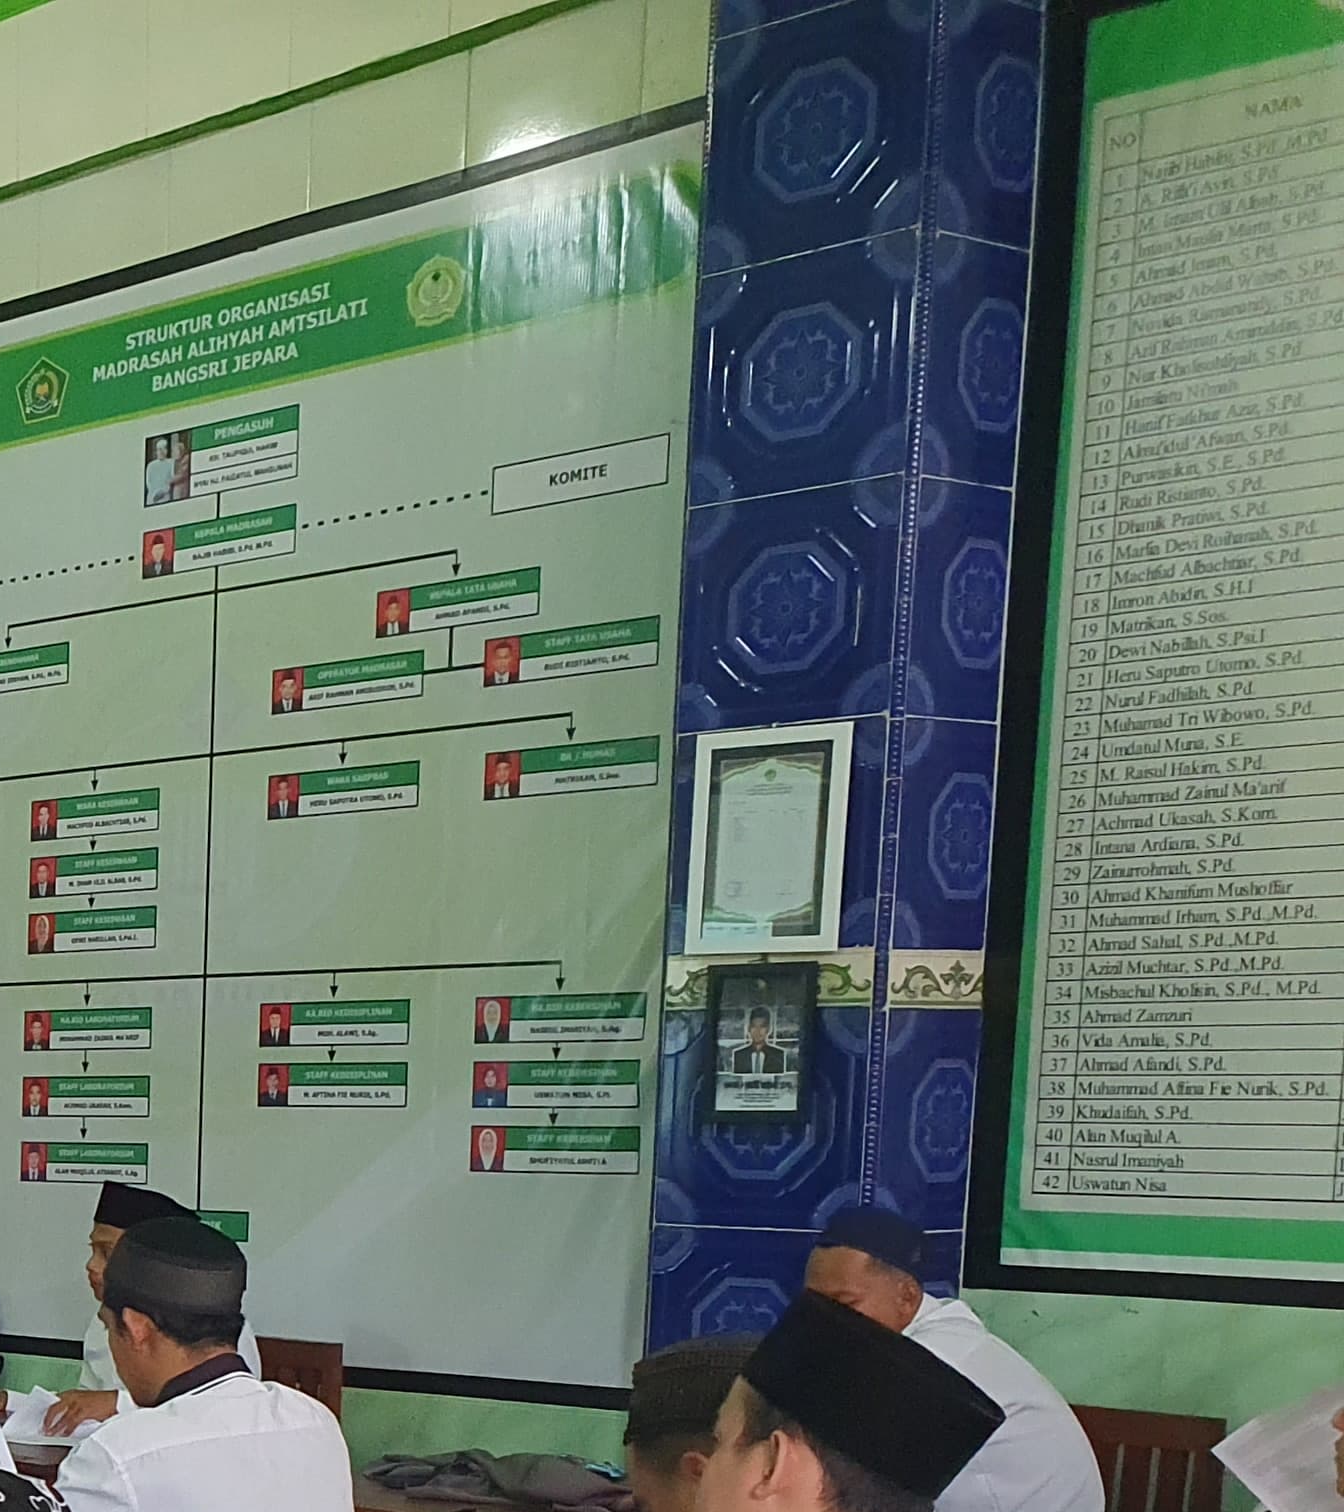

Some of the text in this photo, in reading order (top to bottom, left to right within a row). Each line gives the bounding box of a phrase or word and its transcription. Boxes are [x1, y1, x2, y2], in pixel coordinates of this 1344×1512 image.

[126, 282, 331, 350] STRUKTUR ORGANISASI
[92, 298, 369, 383] MADRASAH ALIHYAH AMTSILATI
[152, 342, 298, 392] BANGSRI JEPARA
[214, 417, 274, 440] PENGASUH
[550, 464, 607, 486] KOMITE
[1075, 697, 1092, 711] 22
[1105, 692, 1144, 710] Nurul
[1073, 722, 1090, 736] 23
[1178, 711, 1198, 727] Tri
[1203, 705, 1270, 724] Wibowo,
[1071, 746, 1089, 759] 24
[1102, 739, 1161, 759] Umdatul
[1070, 770, 1088, 785] 25
[1069, 794, 1086, 807] 26
[1098, 786, 1180, 806] Muhammad
[1185, 781, 1229, 800] Zainul
[1066, 819, 1084, 833] 27
[1096, 813, 1153, 831] Achmad
[1065, 844, 1082, 857] 28
[1063, 867, 1081, 881] 29
[1062, 891, 1080, 905] 30
[1090, 887, 1140, 904] Ahmad
[1060, 914, 1076, 928] 31
[1089, 909, 1170, 928] Muhammad
[1060, 939, 1076, 953] 32
[1088, 933, 1136, 951] Ahmad
[1057, 962, 1074, 977] 33
[1056, 986, 1072, 1000] 34
[1084, 978, 1155, 999] Misbachul
[1054, 1005, 1193, 1024] 35 Ahmad Zamzuri
[1052, 1034, 1070, 1048] 36
[1081, 1031, 1112, 1047] Vida
[1049, 1057, 1067, 1072] 37
[1080, 1053, 1128, 1072] Ahmad
[1047, 1080, 1066, 1095] 38
[1077, 1076, 1158, 1096] Muhammad
[1047, 1104, 1065, 1119] 39
[1045, 1128, 1063, 1142] 40
[1076, 1124, 1106, 1143] Alan
[1043, 1151, 1060, 1165] 41
[1073, 1147, 1120, 1166] Nasrul
[1042, 1172, 1167, 1192] 42 Uswatun Nisa
